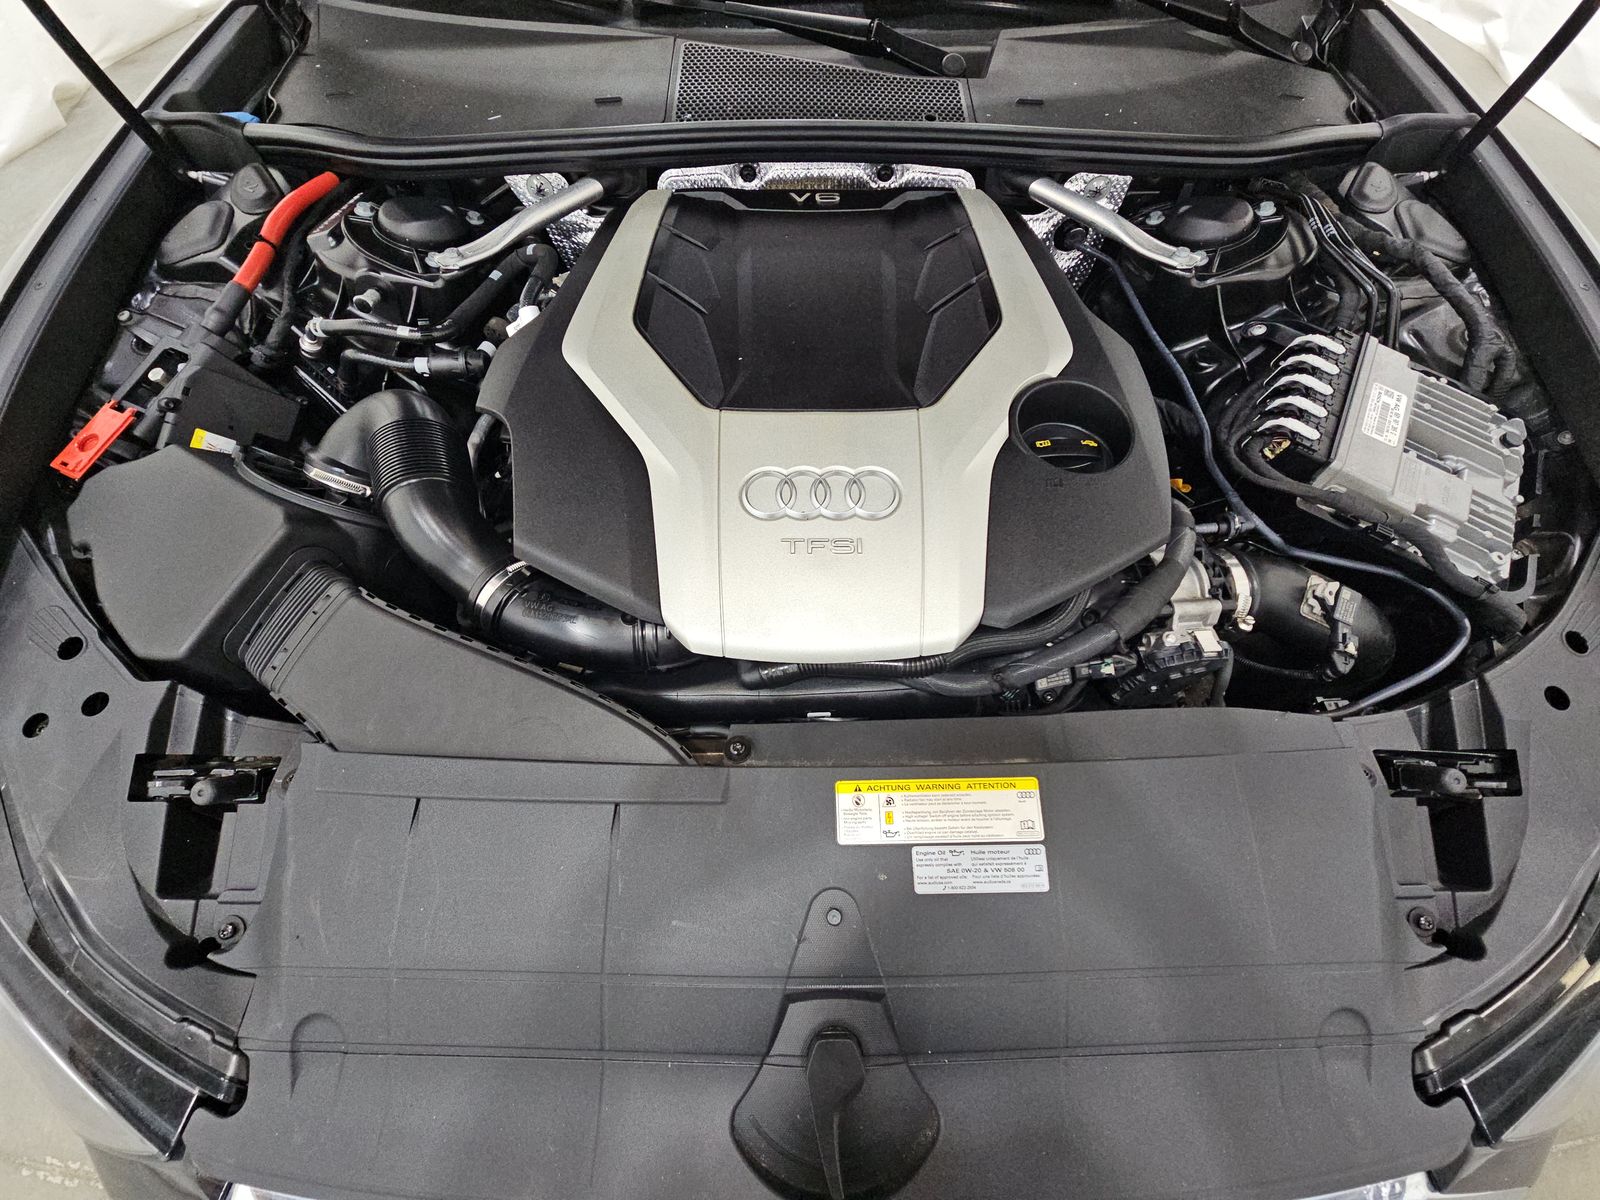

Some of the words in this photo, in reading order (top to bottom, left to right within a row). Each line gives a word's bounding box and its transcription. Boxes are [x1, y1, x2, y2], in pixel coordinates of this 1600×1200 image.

[789, 192, 840, 202] V6
[780, 537, 863, 554] TFSI
[866, 784, 911, 792] ACHTUNG
[915, 783, 961, 791] WARNING
